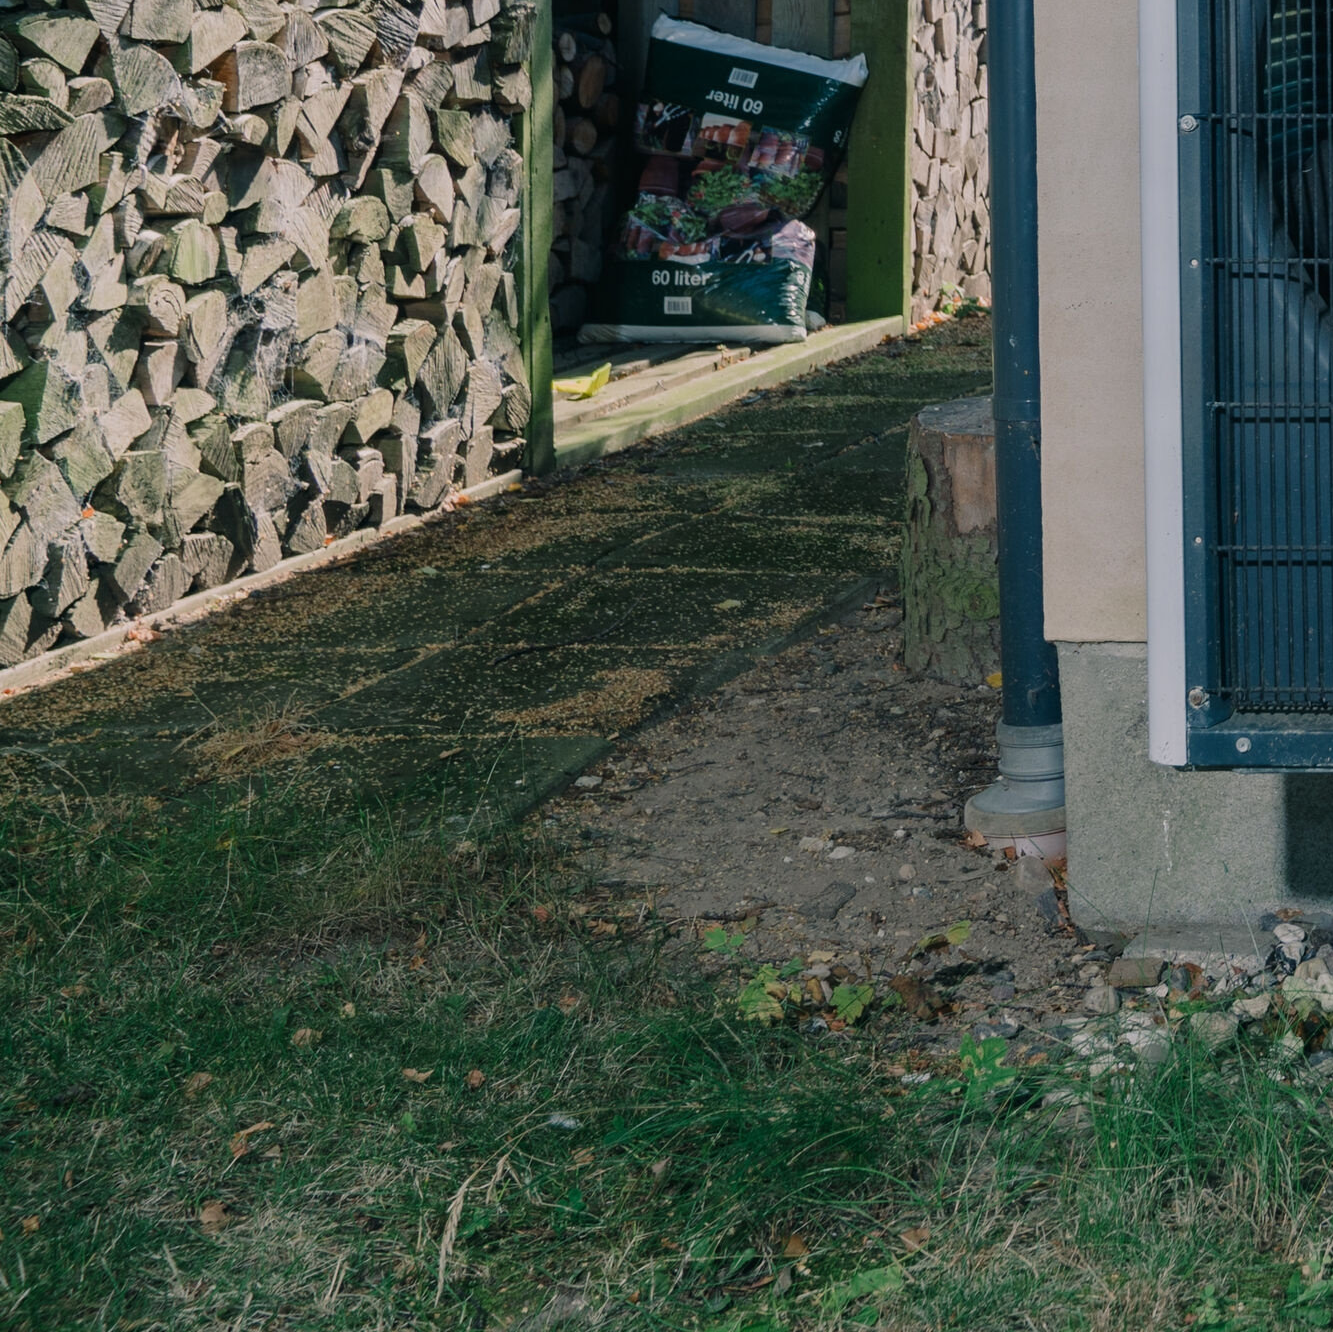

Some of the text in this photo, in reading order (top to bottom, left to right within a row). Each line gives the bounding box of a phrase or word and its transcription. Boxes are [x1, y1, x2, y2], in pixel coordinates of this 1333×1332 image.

[705, 89, 764, 115] 60 liter
[651, 269, 713, 286] 60 liter
